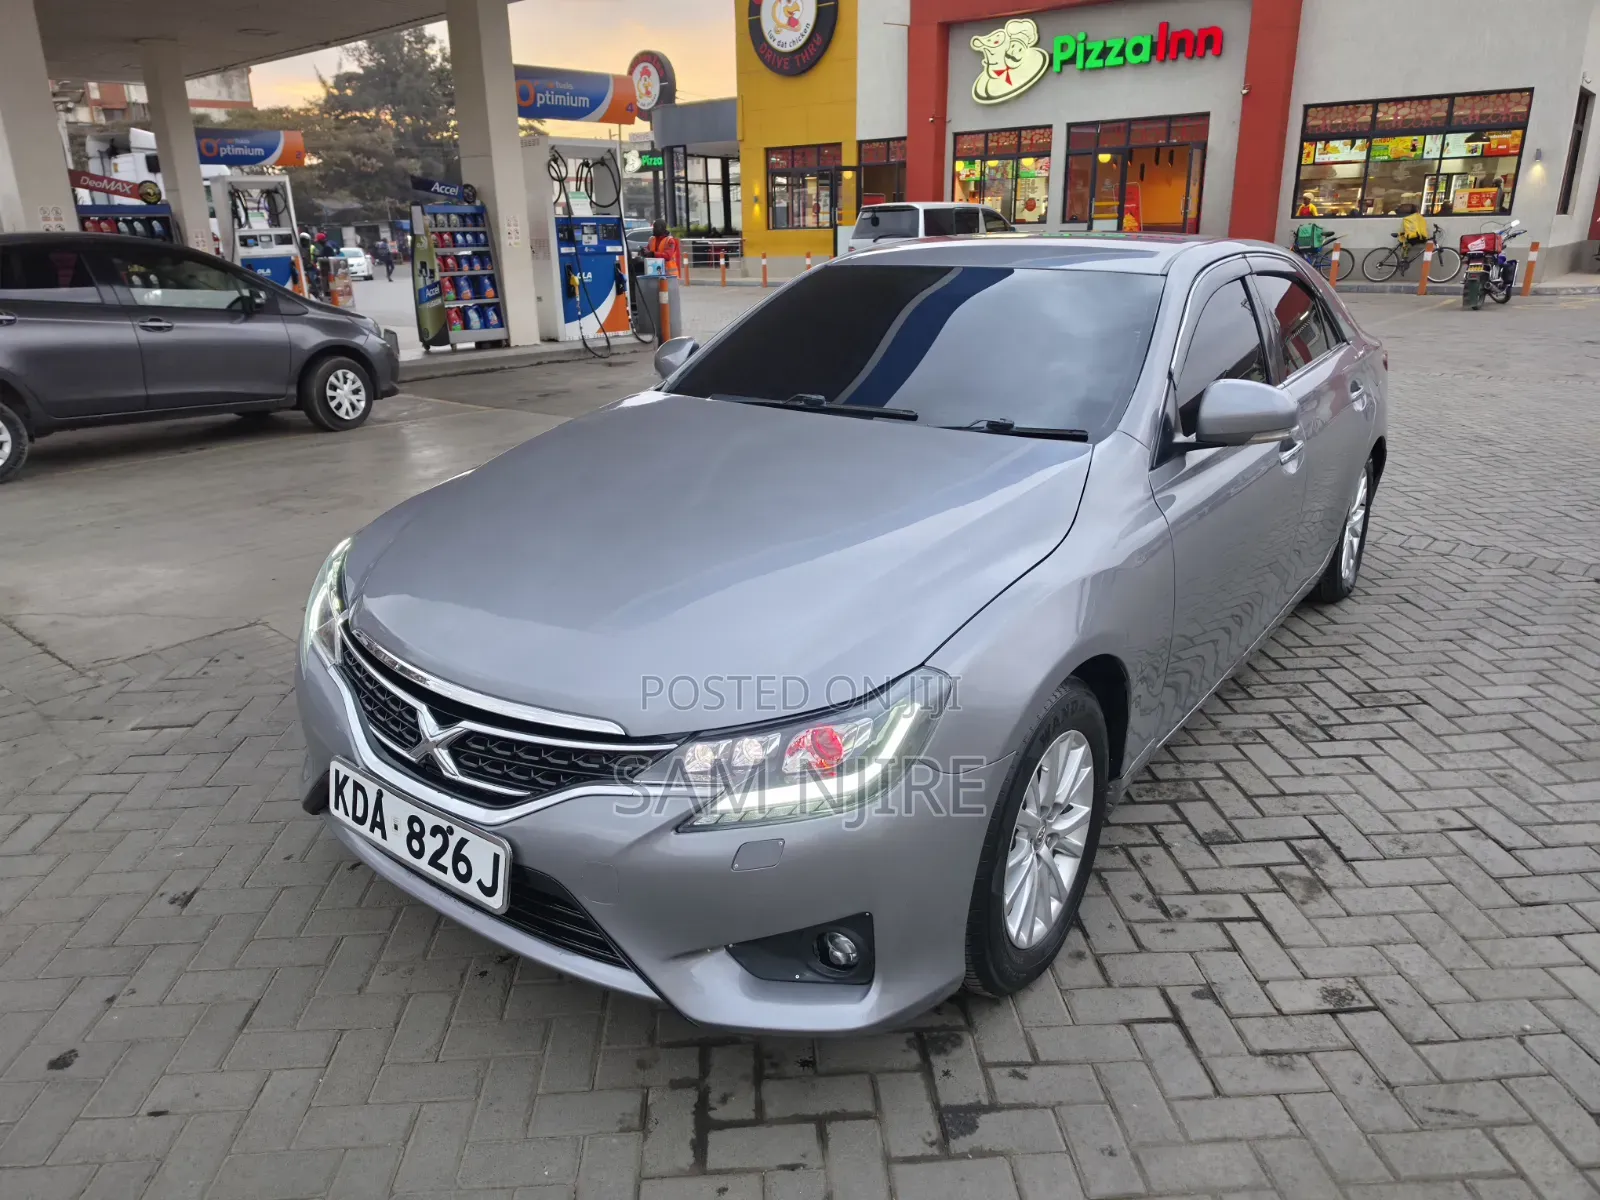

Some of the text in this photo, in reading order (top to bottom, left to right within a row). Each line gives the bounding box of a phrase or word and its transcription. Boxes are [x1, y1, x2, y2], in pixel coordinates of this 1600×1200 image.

[767, 22, 811, 49] luv dat chicken
[759, 32, 823, 70] DRIVE THRU
[626, 102, 635, 113] 4
[200, 138, 265, 157] Optimium
[642, 154, 663, 166] Pizza
[431, 182, 459, 196] Accel
[426, 284, 440, 299] Accel
[334, 769, 501, 898] KDA 826J
